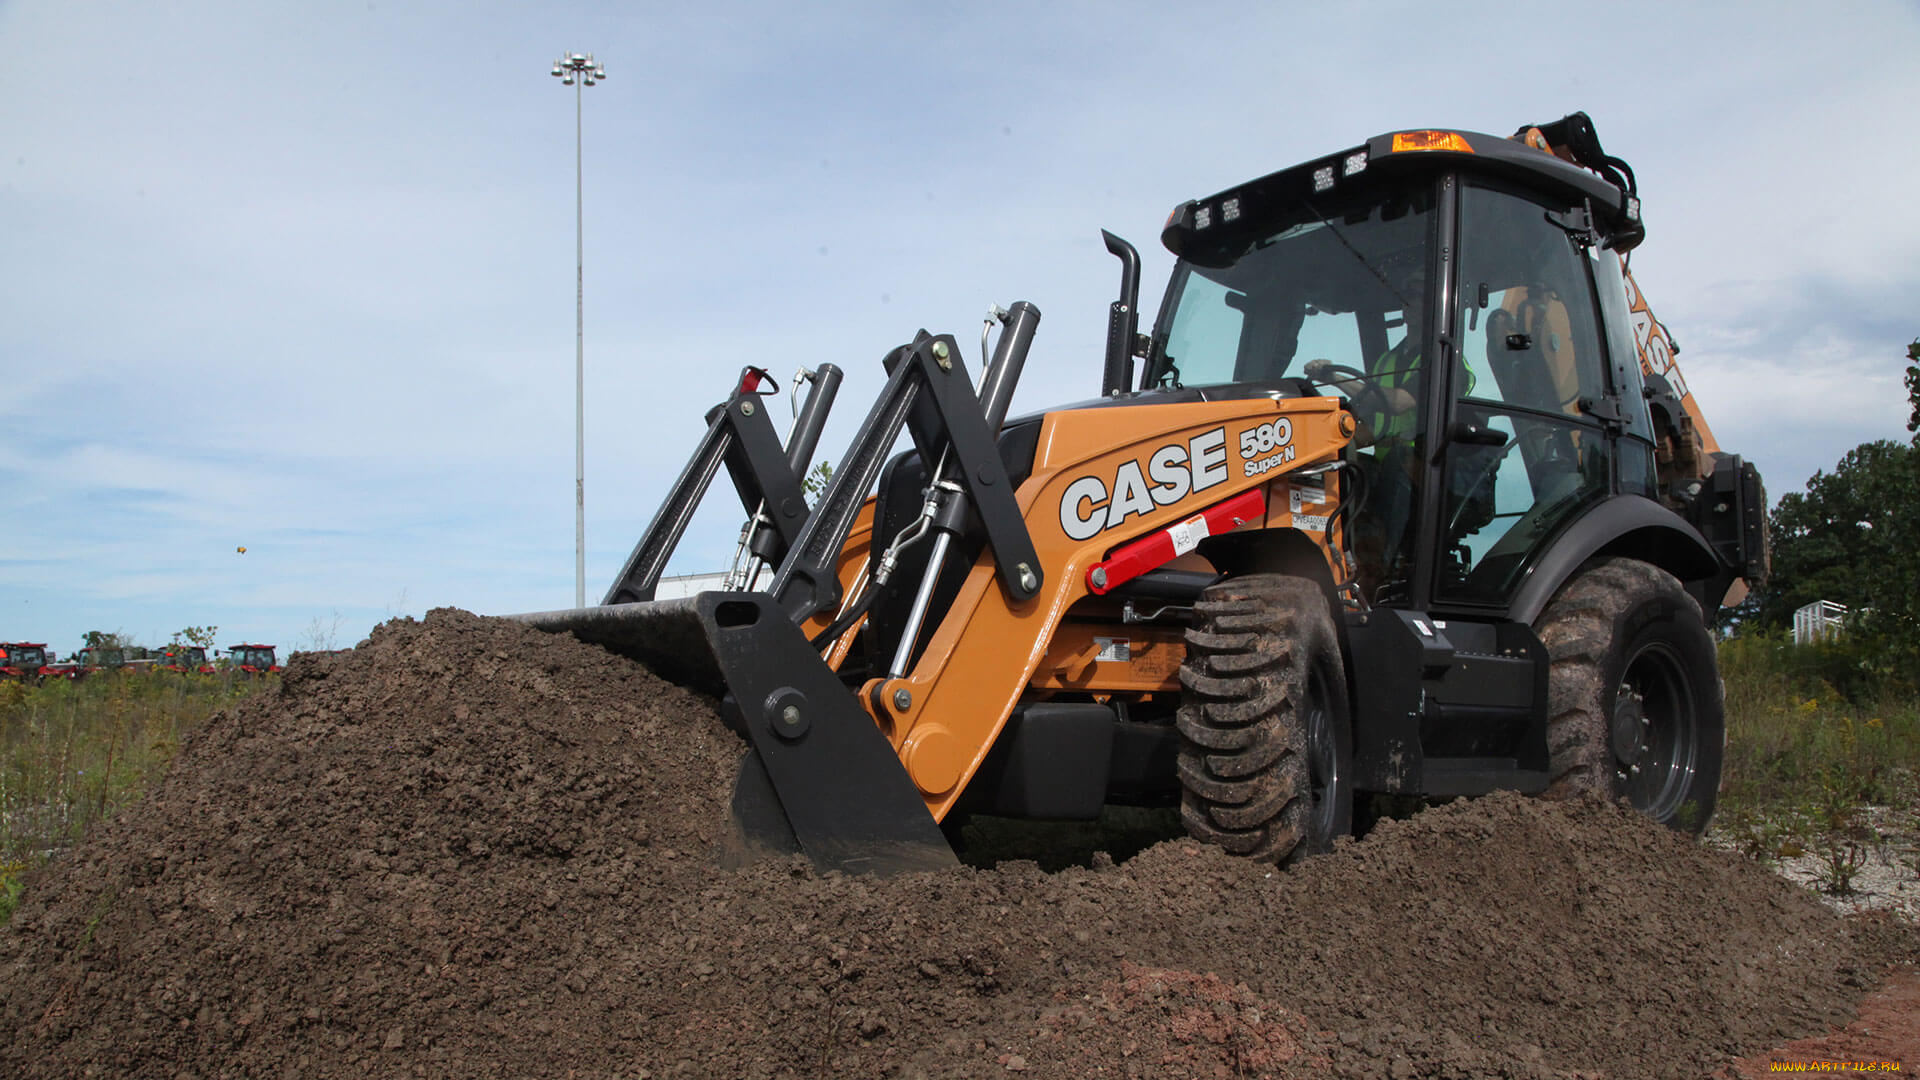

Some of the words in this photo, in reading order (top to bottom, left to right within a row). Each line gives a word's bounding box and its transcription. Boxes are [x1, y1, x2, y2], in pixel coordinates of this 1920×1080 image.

[1239, 417, 1293, 459] 580
[1244, 452, 1284, 477] Super
[1284, 444, 1296, 462] N
[1059, 426, 1229, 541] CASE
